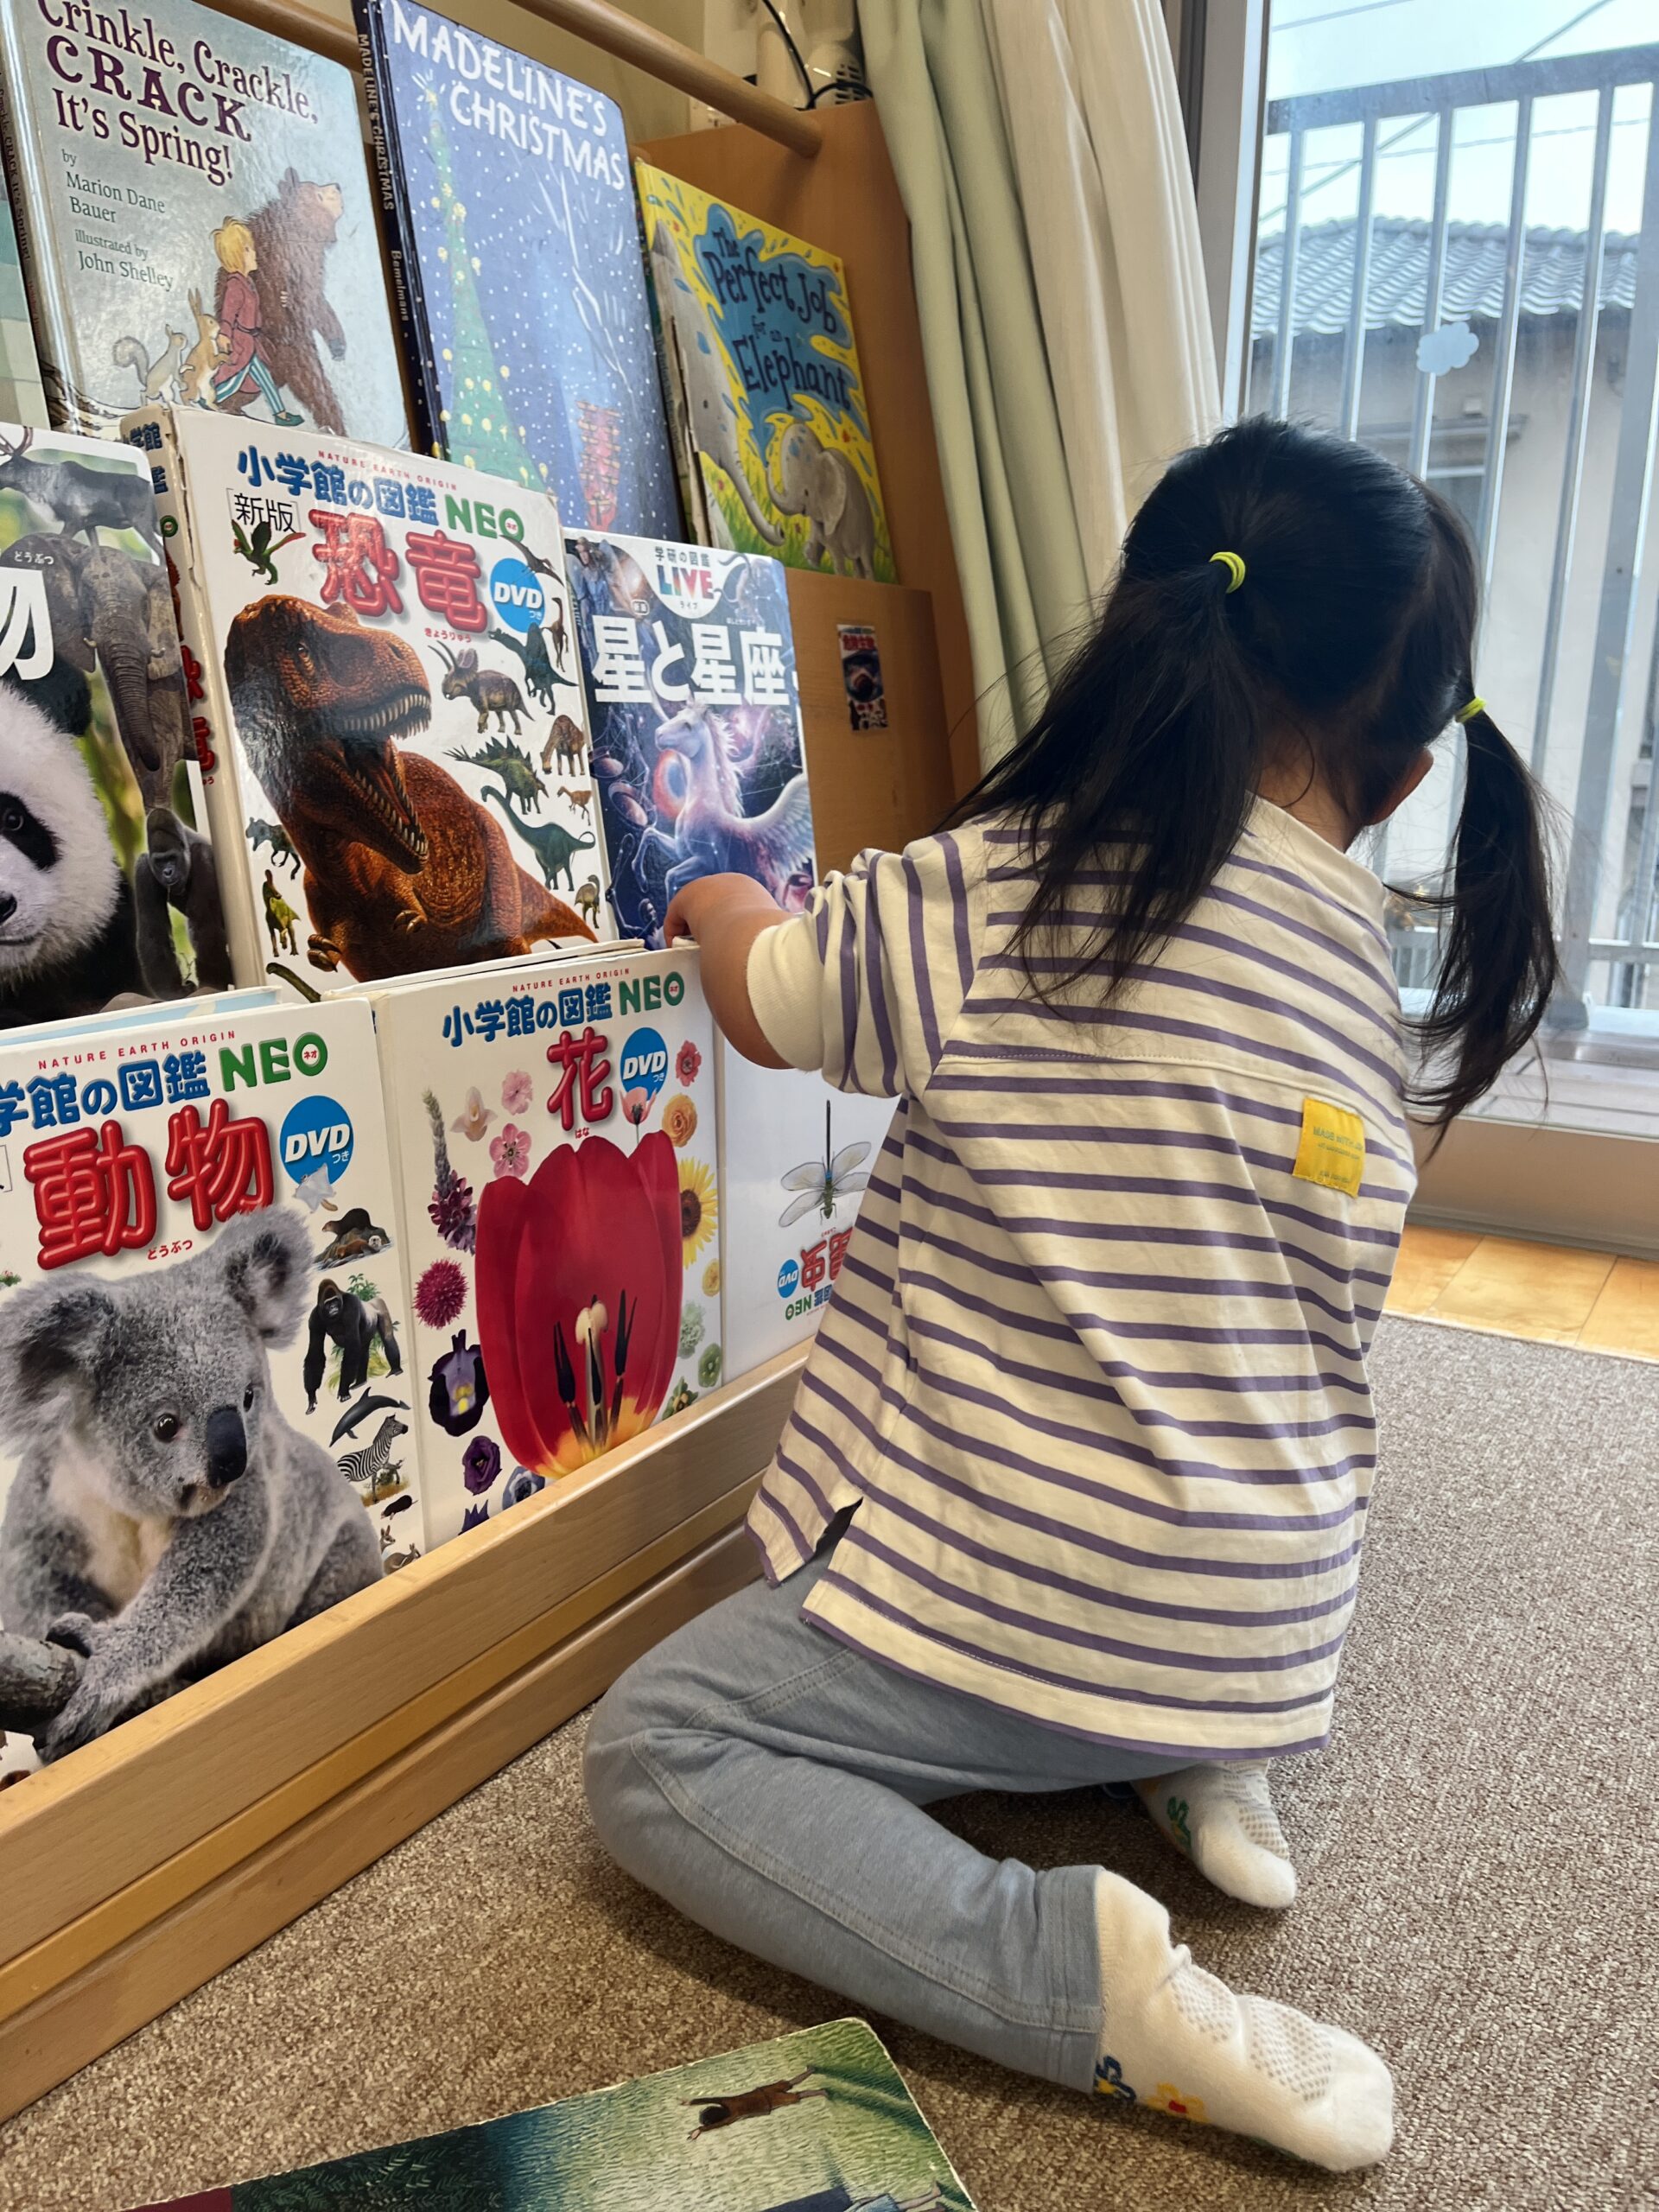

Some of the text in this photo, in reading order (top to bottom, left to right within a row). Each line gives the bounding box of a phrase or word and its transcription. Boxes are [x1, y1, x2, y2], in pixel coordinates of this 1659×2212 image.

[37, 0, 319, 124] Crinkle, Crackle,
[393, 0, 607, 137] MADELINE'S
[47, 35, 252, 143] CRACK
[52, 89, 234, 187] It's Spring!
[61, 149, 77, 167] by
[449, 85, 626, 191] CHRISTMAS
[66, 171, 166, 213] Marion Dane
[358, 34, 410, 322] MADELINE'S CHRISTMAS Bemelmans
[69, 196, 116, 223] Bauer
[75, 229, 149, 261] illustrated by
[712, 227, 741, 257] The
[78, 251, 174, 292] John Shelley
[702, 245, 837, 334] Perfect Job
[732, 334, 851, 411] Elephant
[238, 445, 439, 526] 小学館の図鑑
[318, 450, 457, 491] NATURE EARTH ORIGIN
[233, 493, 298, 534] 新版
[445, 493, 524, 542] NEO
[14, 550, 54, 565] どうぶつ
[308, 508, 488, 633] 恐竜
[493, 582, 543, 609] DVD
[657, 564, 714, 600] LIVE
[591, 614, 791, 707] 星と星座
[512, 968, 630, 993] NATURE EARTH ORIGIN
[618, 971, 685, 1016] NEO
[442, 982, 613, 1048] 小学館の図鑑
[38, 1030, 236, 1070] NATURE EARTH ORIGIN
[219, 1031, 328, 1092] NEO
[303, 1050, 318, 1060] ネオ
[623, 1050, 666, 1080] DVD
[546, 1027, 613, 1132] 花
[285, 1122, 351, 1163] DVD
[333, 1150, 350, 1164] つき
[23, 1098, 275, 1271] 動物
[147, 1239, 193, 1261] どうぶつ
[778, 1269, 798, 1287] DVD
[785, 1294, 811, 1320] NEO
